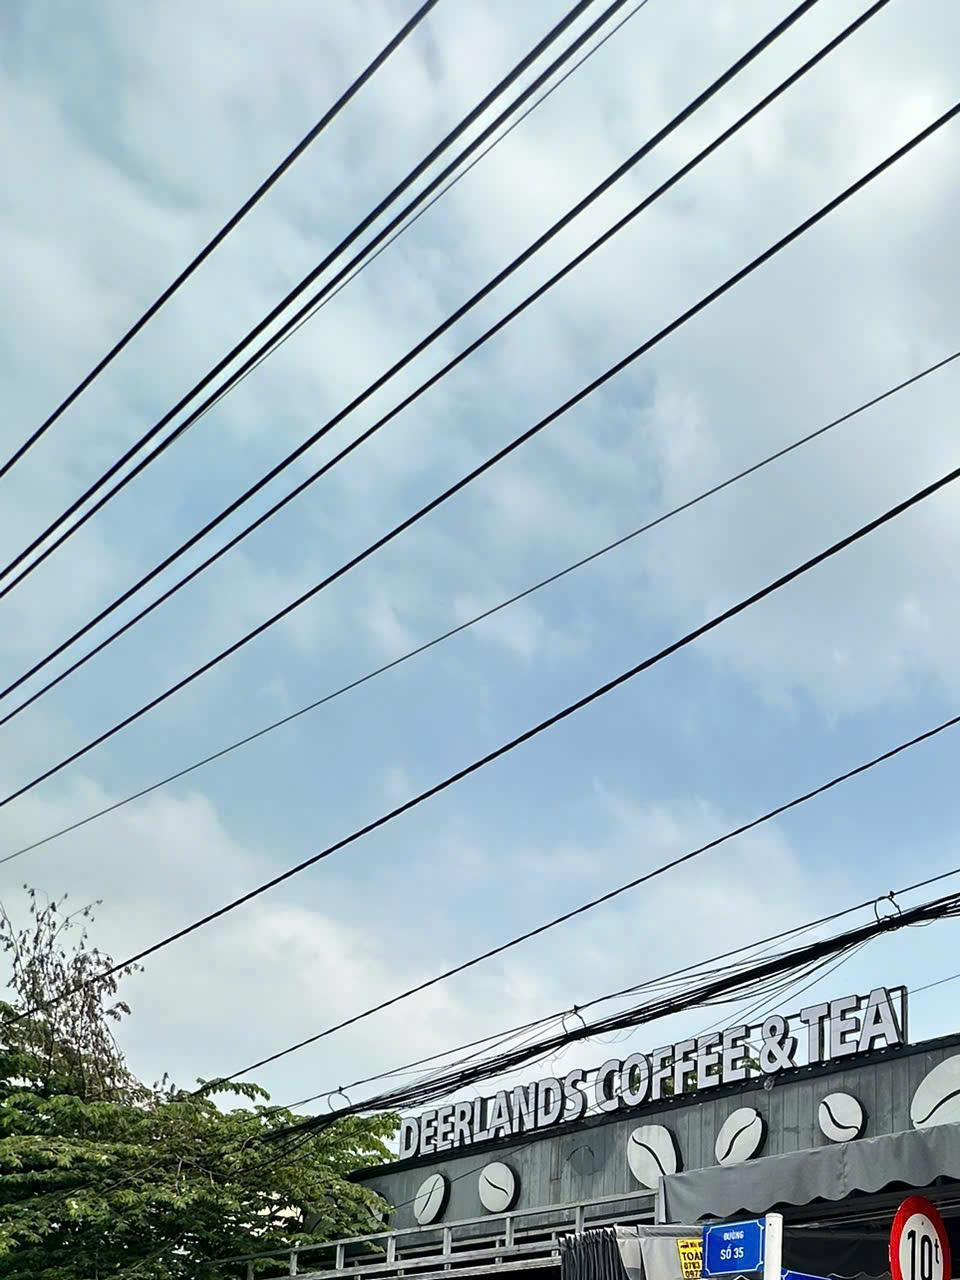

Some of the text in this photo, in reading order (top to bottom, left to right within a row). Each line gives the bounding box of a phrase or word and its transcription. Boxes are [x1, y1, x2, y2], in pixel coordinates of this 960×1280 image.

[400, 987, 903, 1160] DEERLANDS COFFEE & TEA
[720, 1243, 732, 1260] SỐ
[733, 1247, 744, 1259] 35
